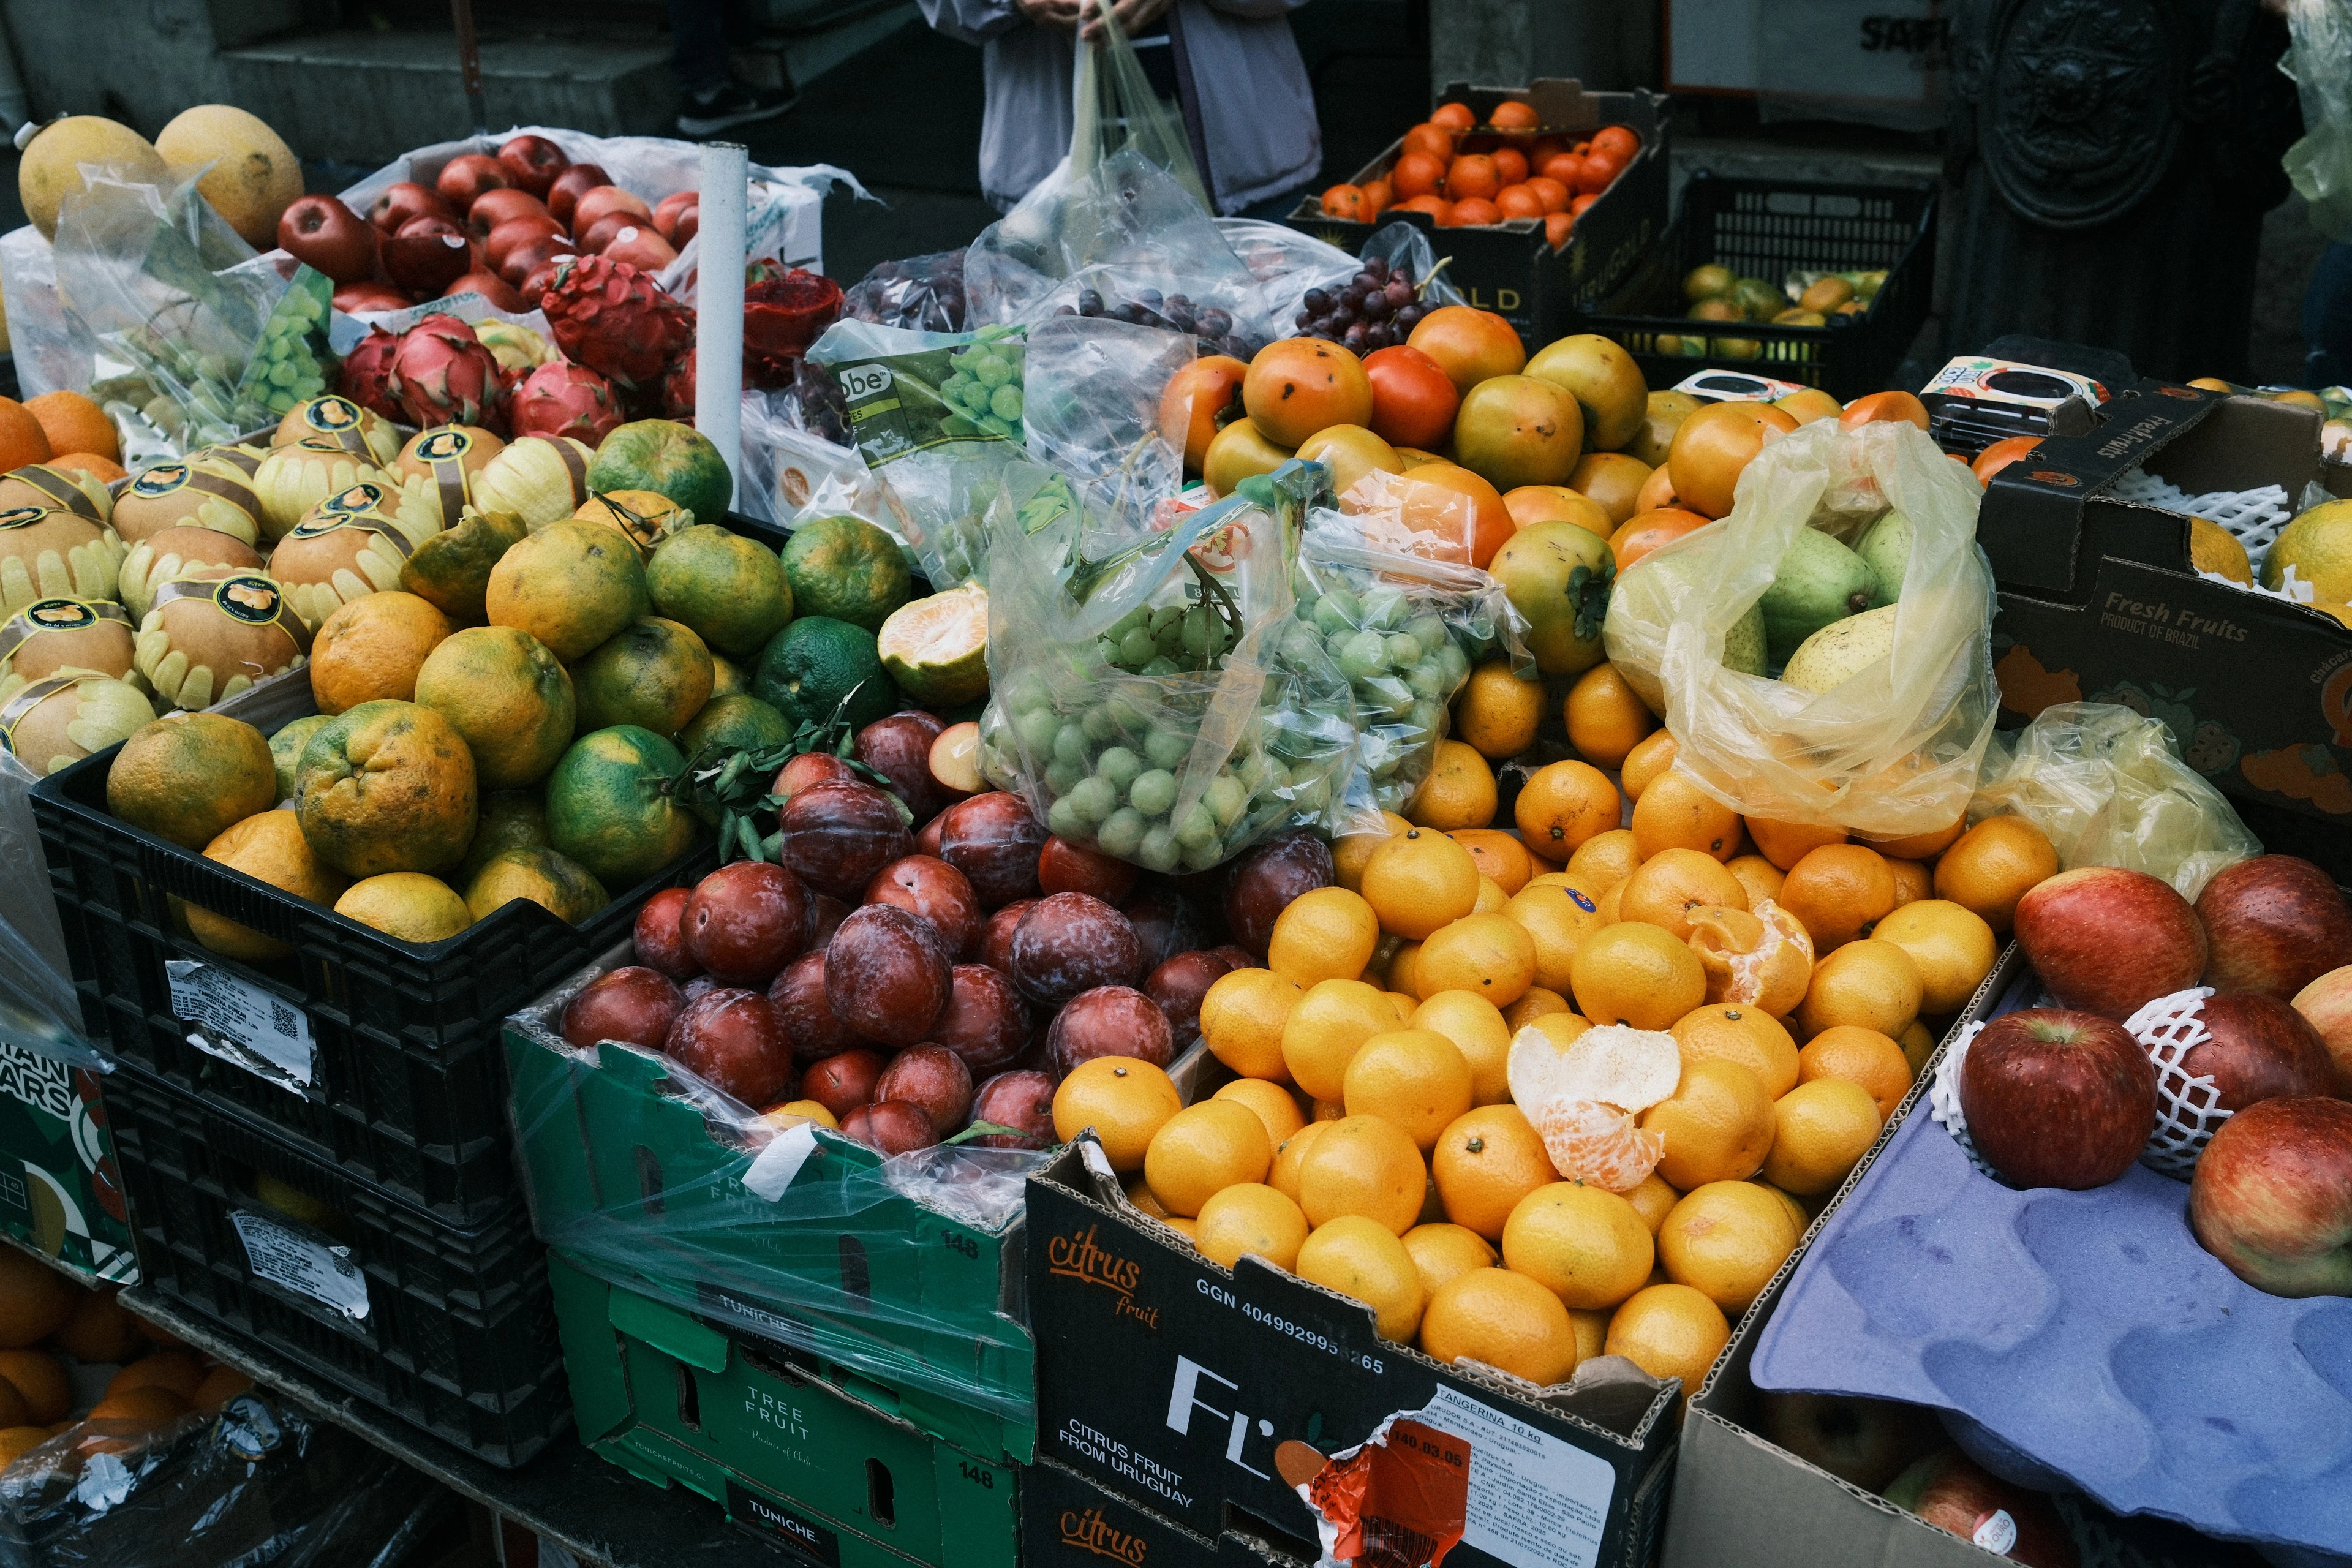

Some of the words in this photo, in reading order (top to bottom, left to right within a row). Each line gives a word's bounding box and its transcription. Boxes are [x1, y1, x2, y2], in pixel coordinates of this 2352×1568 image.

[2101, 612, 2147, 635] PRODUCT
[2149, 624, 2163, 639] OF
[2165, 628, 2200, 650] BRAZIL
[2105, 592, 2170, 622] Fresh
[2176, 610, 2248, 643] Fruits
[197, 988, 226, 1007] TANGERINA
[228, 1004, 246, 1019] PONKAN
[940, 1229, 979, 1260] 148
[1049, 1225, 1140, 1290] citrus
[1115, 1295, 1159, 1329] fruit
[1197, 1278, 1235, 1308] GGN
[720, 1294, 791, 1332] TUNICHE
[745, 1400, 809, 1441] FRUIT
[747, 1385, 803, 1423] TREE
[1440, 1389, 1504, 1426] TANGERINA
[1512, 1423, 1523, 1434] 10
[1528, 1431, 1540, 1444] kg
[1444, 1415, 1482, 1438] Montevideo
[634, 1441, 706, 1482] TUNICHEFRUITS.CL
[1060, 1429, 1106, 1464] FROM
[1112, 1456, 1193, 1508] URUGUAY
[1069, 1419, 1128, 1459] CITRUS
[1134, 1452, 1182, 1487] FRUIT
[1482, 1455, 1514, 1477] Paysandu
[959, 1461, 993, 1490] 148
[1474, 1460, 1493, 1474] Paulo
[1545, 1493, 1583, 1517] exportação
[1470, 1488, 1487, 1501] 11.00
[1488, 1497, 1496, 1506] kg
[1503, 1504, 1519, 1516] Peso
[1539, 1521, 1555, 1533] 10.00
[1558, 1530, 1566, 1539] kg
[1491, 1476, 1514, 1491] Jardim
[1517, 1488, 1536, 1502] Santo
[1538, 1498, 1555, 1510] Elias
[1561, 1509, 1574, 1519] São
[1577, 1515, 1596, 1529] Paulo
[1060, 1509, 1147, 1563] citrus
[1492, 1521, 1519, 1539] Produto
[1521, 1535, 1541, 1549] isento
[1554, 1551, 1568, 1562] data
[1494, 1515, 1510, 1526] local
[1512, 1523, 1532, 1537] fresco
[1540, 1537, 1555, 1548] seco
[1569, 1551, 1581, 1561] sob
[1503, 1511, 1528, 1528] SAFRA:
[1531, 1525, 1546, 1536] 2025
[1565, 1525, 1597, 1546] Florcitrus
[1992, 1519, 2010, 1542] OURO
[1510, 1537, 1545, 1558] 21/07/2022
[1552, 1558, 1567, 1568] RDC
